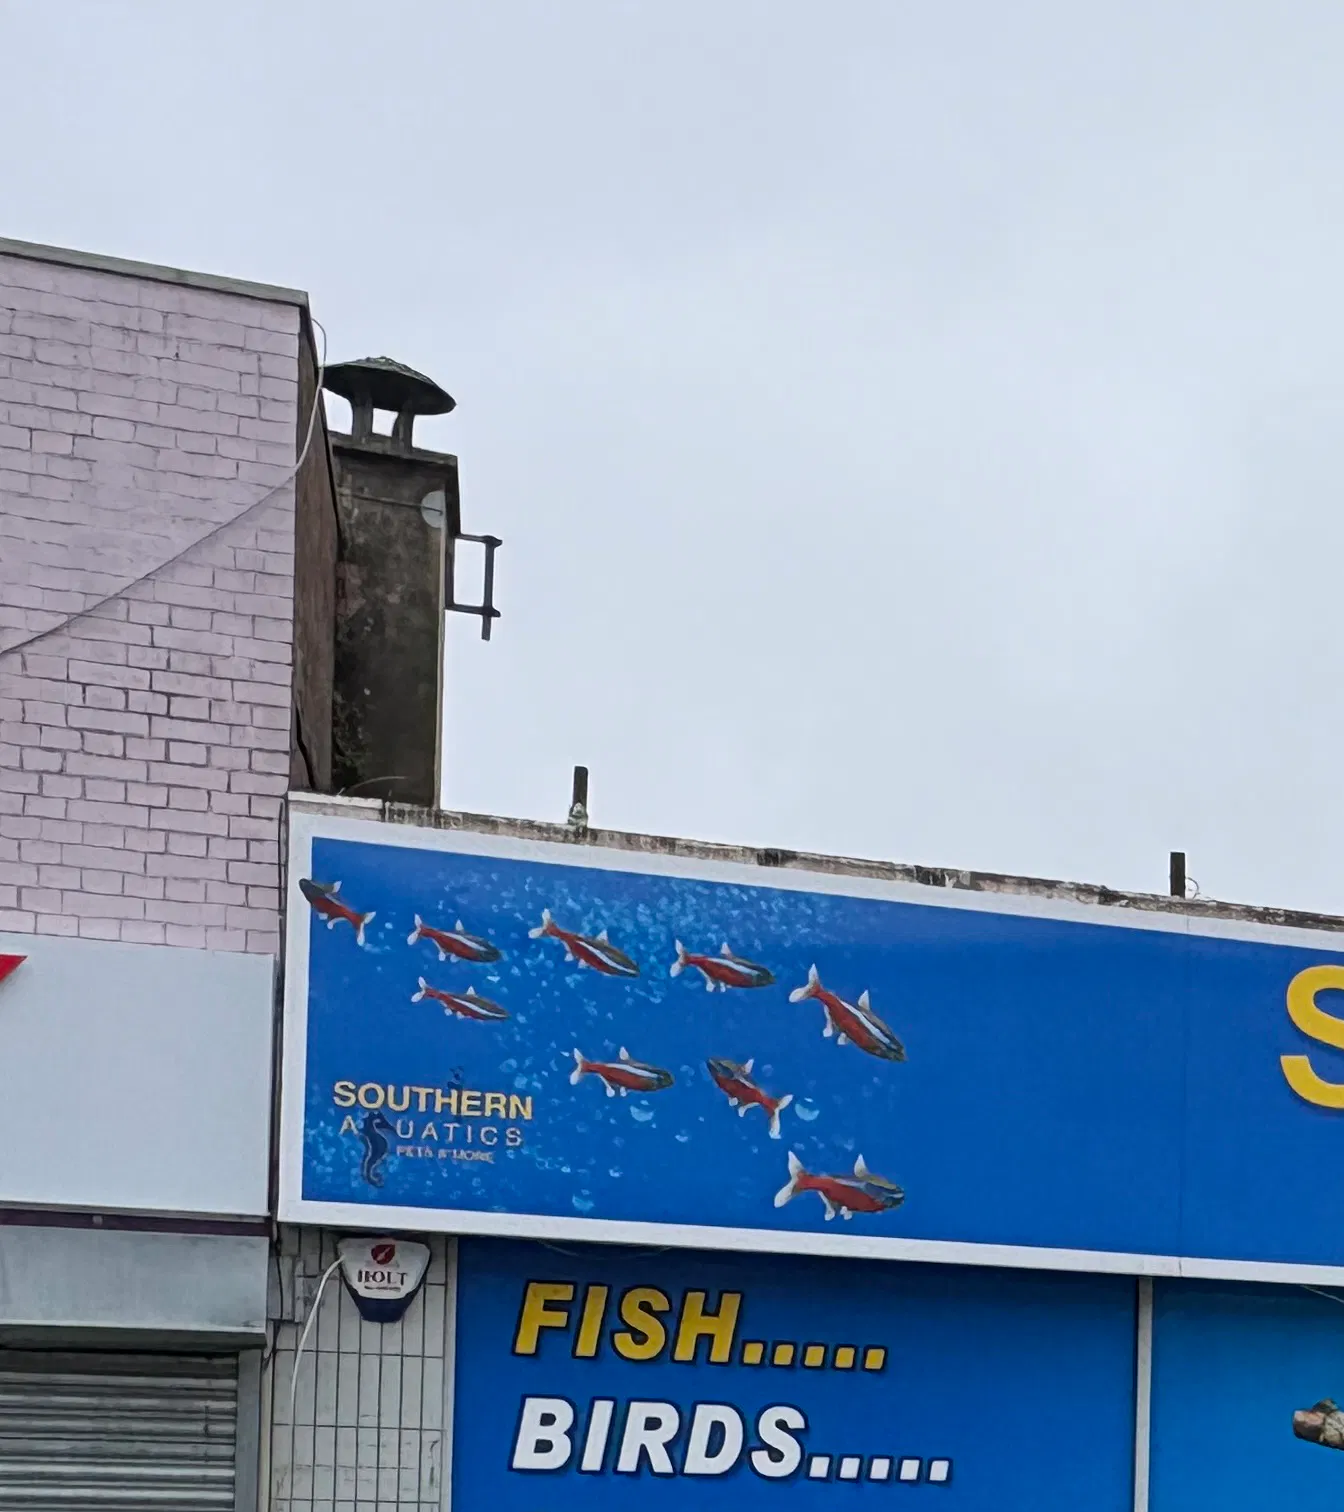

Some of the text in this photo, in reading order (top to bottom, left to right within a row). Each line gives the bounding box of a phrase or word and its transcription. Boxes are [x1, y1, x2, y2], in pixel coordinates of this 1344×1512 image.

[333, 1080, 533, 1120] SOUTHERN
[339, 1115, 522, 1146] AUATICS
[512, 1281, 887, 1371] FISH.....
[510, 1396, 952, 1481] BIRDS.....
